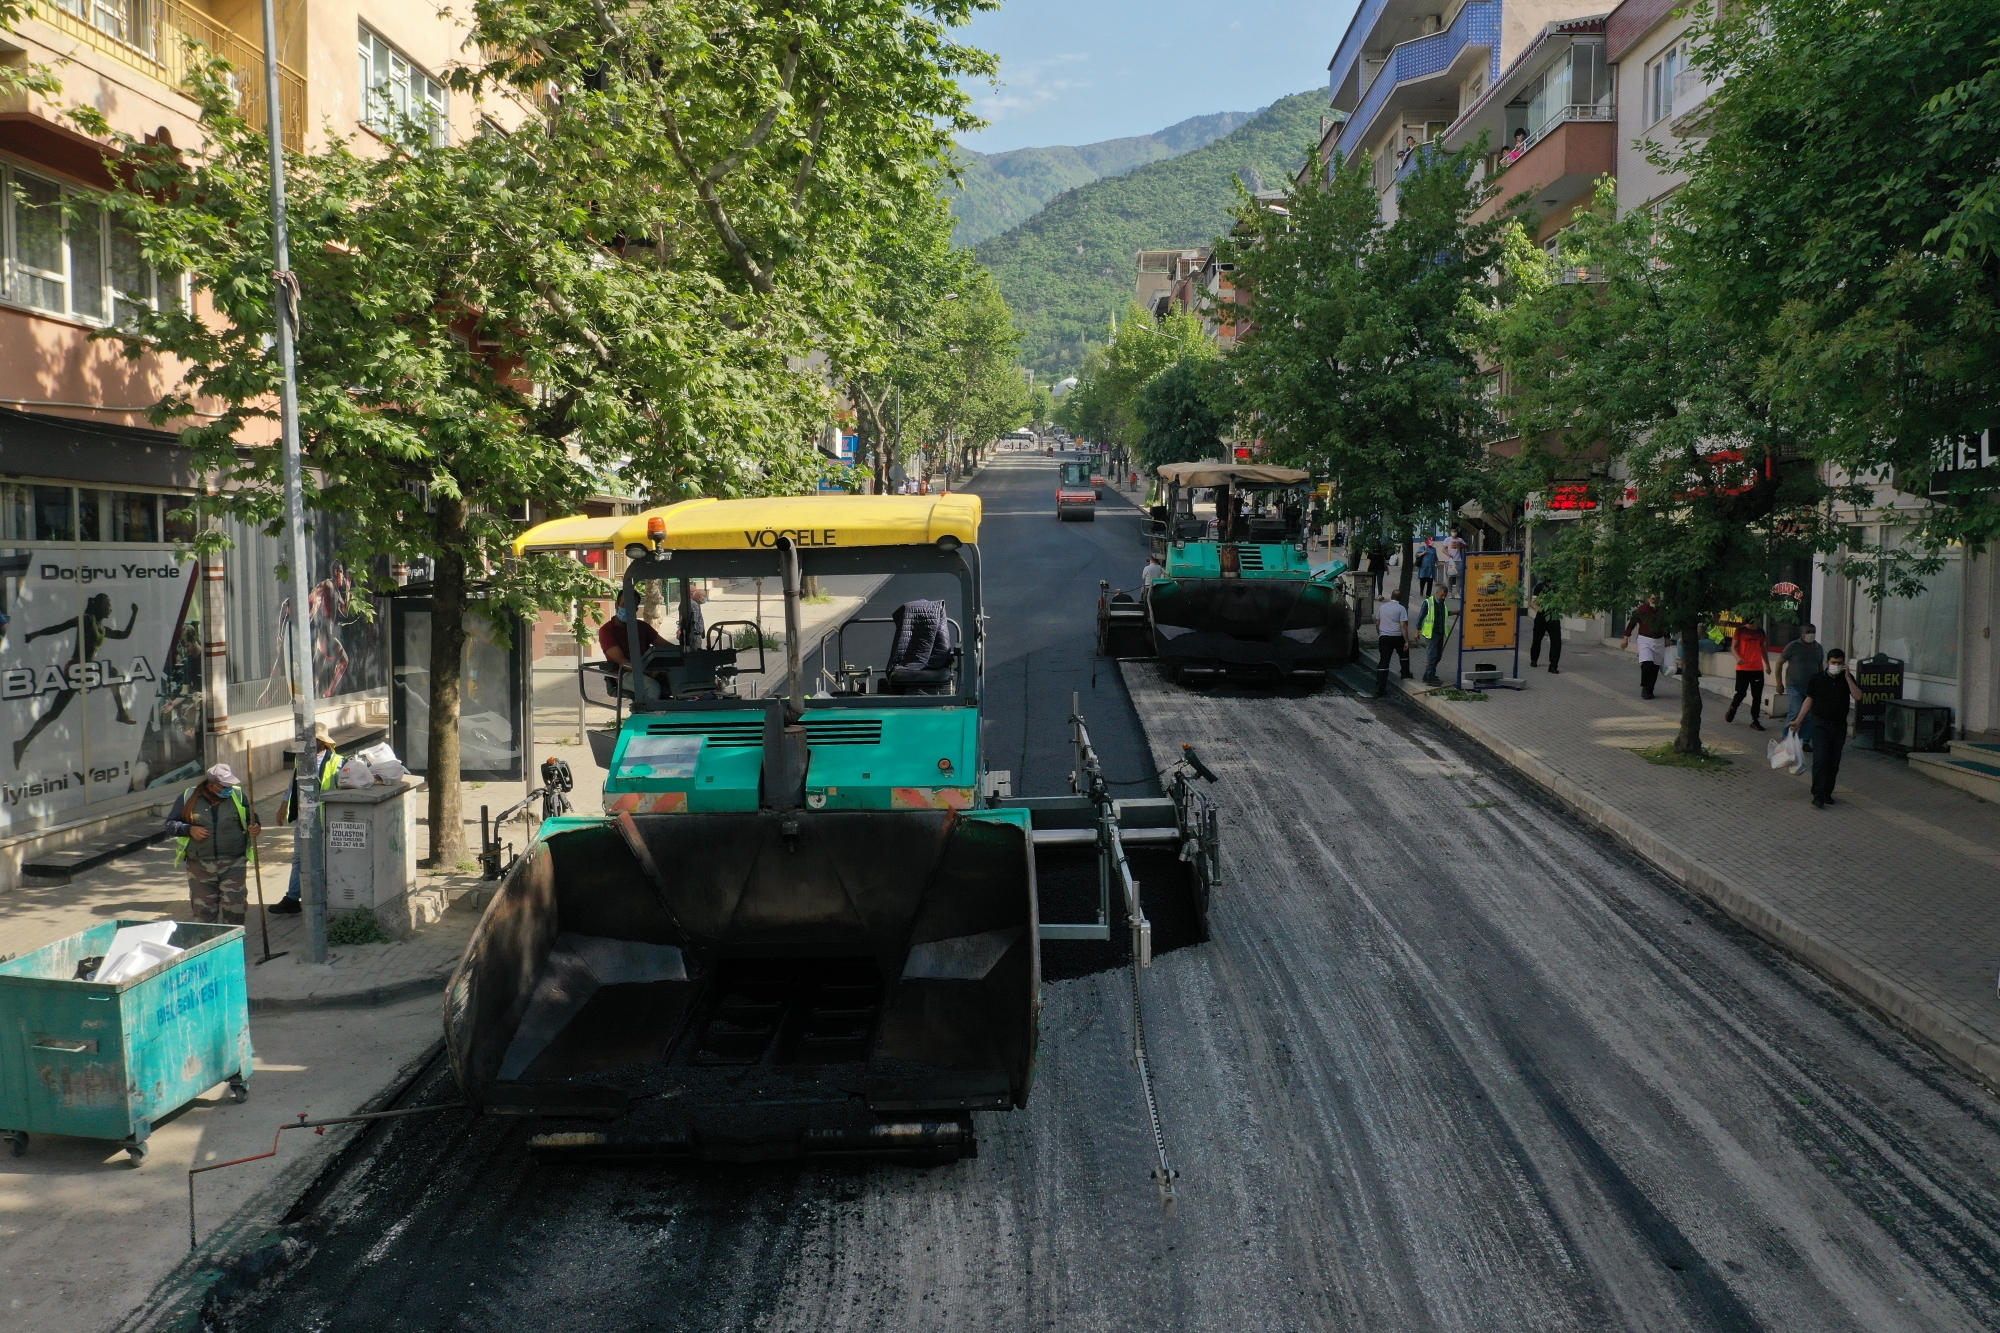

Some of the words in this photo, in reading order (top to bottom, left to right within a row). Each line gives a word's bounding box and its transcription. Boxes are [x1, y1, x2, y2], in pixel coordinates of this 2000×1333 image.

[40, 564, 117, 584] Doğru
[121, 563, 180, 579] Yerde
[1, 655, 156, 701] BAŞLA
[1860, 673, 1900, 686] MELEK
[1862, 692, 1895, 705] MODA
[3, 773, 69, 806] İyisini
[72, 765, 120, 786] Yap
[123, 760, 130, 776] !
